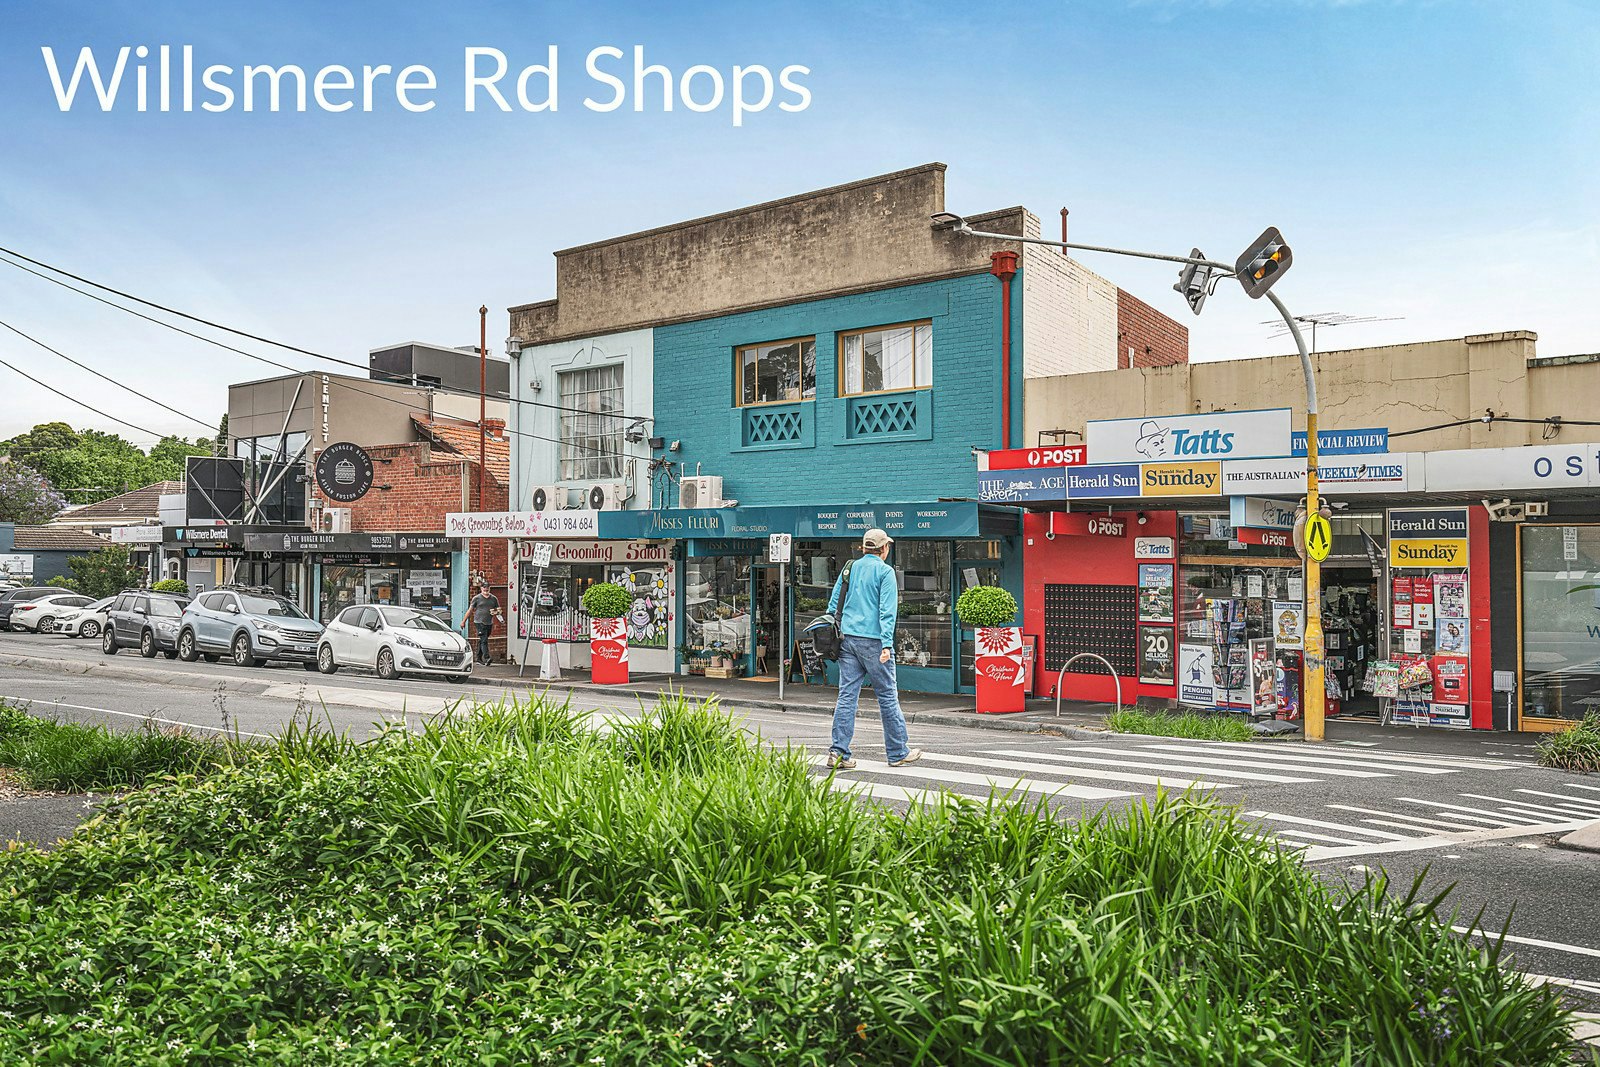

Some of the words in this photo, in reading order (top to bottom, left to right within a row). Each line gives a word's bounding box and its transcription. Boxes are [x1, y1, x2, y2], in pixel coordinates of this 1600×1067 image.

[1171, 429, 1234, 455] Tatts
[1293, 436, 1344, 450] FINNCIAL
[1346, 434, 1386, 448] REVIEW
[321, 452, 329, 464] THE
[332, 445, 354, 454] BURGER
[356, 449, 369, 466] BLOCK
[1044, 449, 1082, 464] POST
[1146, 468, 1217, 488] Sunday
[1226, 473, 1244, 481] THE
[1244, 471, 1300, 480] AUSTRALIAN
[1367, 465, 1402, 478] TIMES
[980, 480, 1004, 491] THE
[1039, 476, 1065, 489] AGE
[1069, 475, 1109, 488] Herald
[1112, 474, 1138, 487] Sun
[320, 479, 334, 494] ASIAN
[336, 490, 356, 500] FUSION
[358, 481, 368, 494] CAFE
[650, 512, 683, 533] MISSES
[688, 516, 719, 529] FLEURI
[1276, 508, 1296, 526] Tatt
[1391, 518, 1436, 531] Herald
[1438, 518, 1466, 530] Sun
[451, 518, 466, 533] Dog
[468, 517, 502, 534] Grooming
[505, 516, 526, 530] Salon
[544, 518, 562, 530] 0431
[564, 518, 577, 530] 984
[579, 518, 593, 530] 684
[1099, 522, 1124, 536] POST
[186, 529, 210, 539] Willsmere
[210, 528, 228, 539] Dental
[1269, 535, 1286, 546] POST
[556, 543, 613, 562] Grooming
[626, 542, 666, 560] Salon
[1149, 544, 1170, 554] Tatts
[1398, 544, 1458, 562] Sunday
[1144, 636, 1168, 652] $20
[986, 664, 1014, 674] Christmas
[994, 672, 1012, 682] Home
[1184, 686, 1212, 695] PENGUIN
[1435, 706, 1460, 714] Sunday
